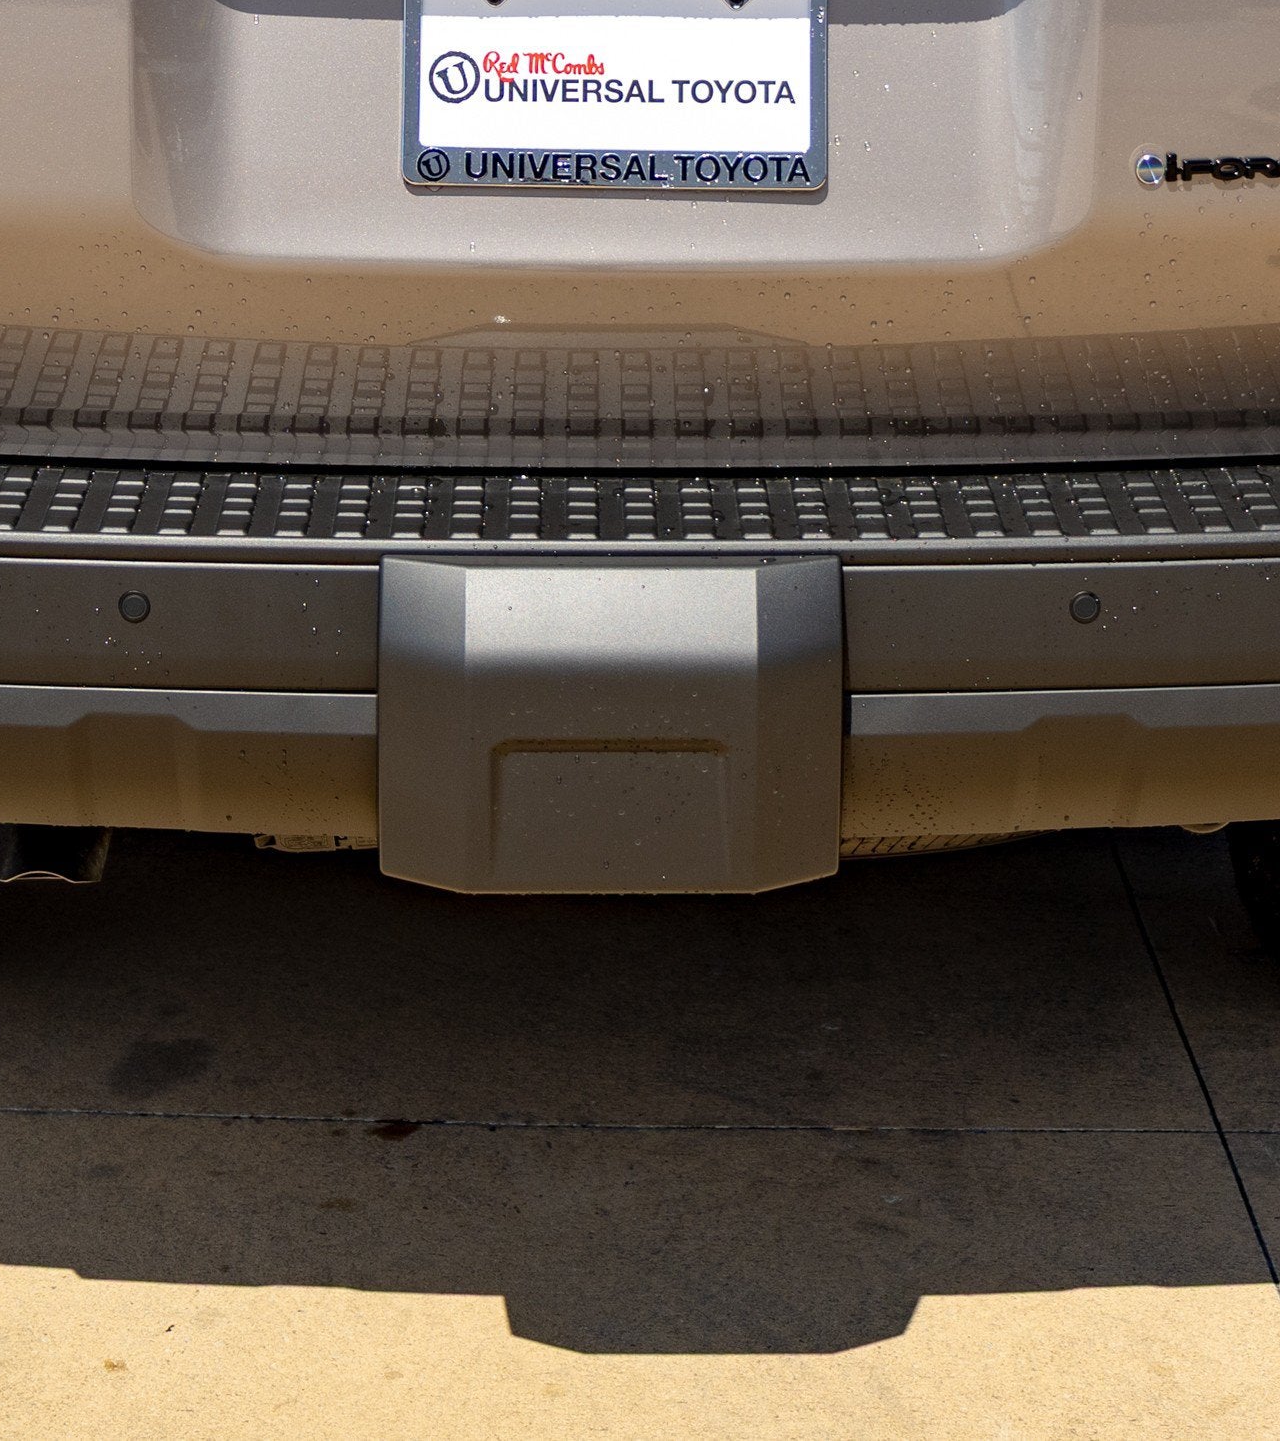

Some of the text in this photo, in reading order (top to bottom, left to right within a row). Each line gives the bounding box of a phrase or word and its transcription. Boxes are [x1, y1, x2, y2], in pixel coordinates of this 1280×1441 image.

[482, 51, 605, 82] Red McCombs
[484, 78, 796, 105] UNIVERSAL TOYOTA
[465, 151, 668, 182] UNIVERSAL
[673, 154, 812, 184] TOYOTA
